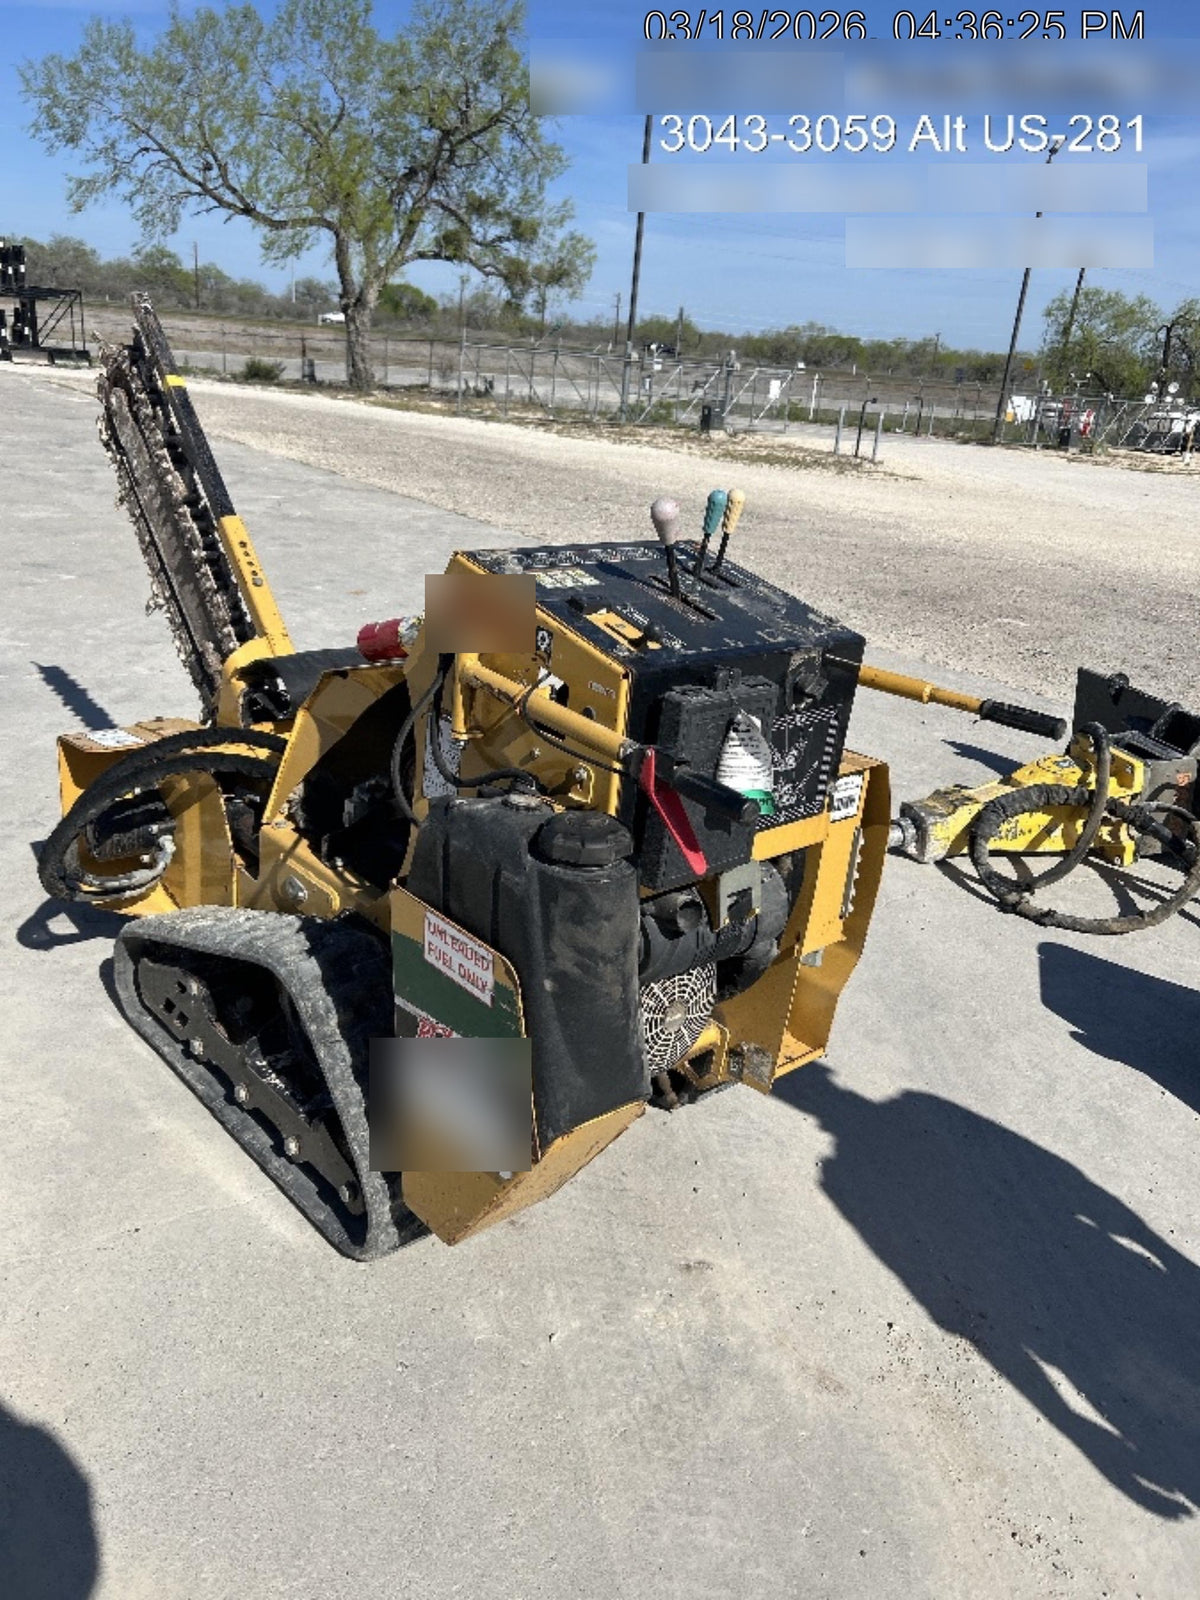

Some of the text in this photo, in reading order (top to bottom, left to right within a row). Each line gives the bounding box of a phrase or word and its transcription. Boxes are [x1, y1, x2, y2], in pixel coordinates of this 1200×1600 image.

[428, 921, 492, 972] UNLEADED
[428, 941, 488, 994] FUEL ONLY
